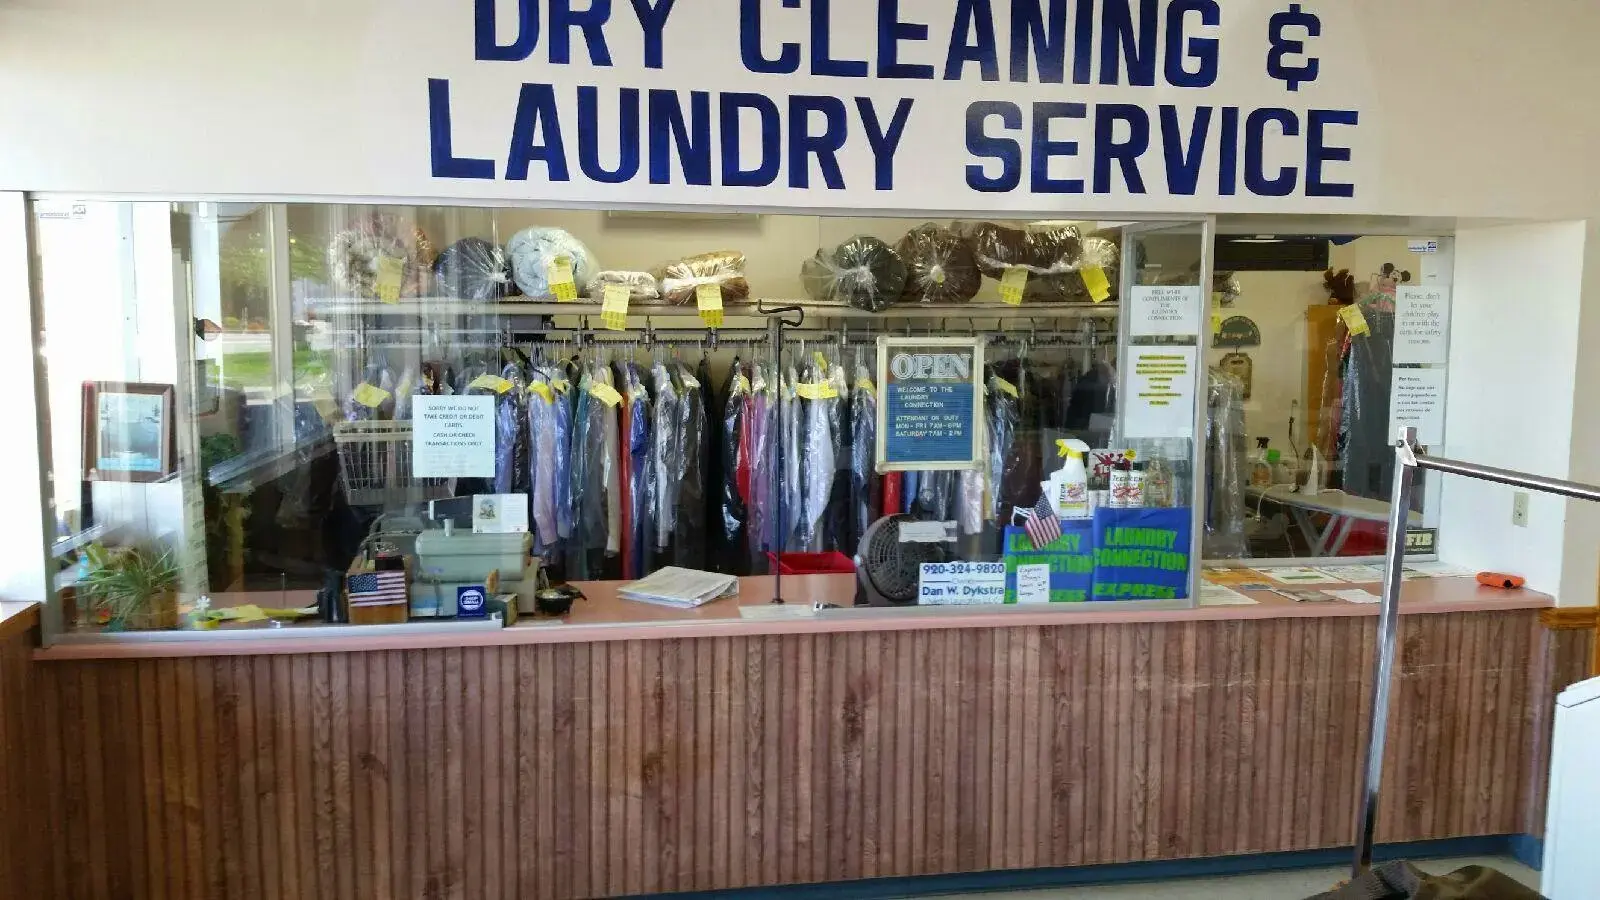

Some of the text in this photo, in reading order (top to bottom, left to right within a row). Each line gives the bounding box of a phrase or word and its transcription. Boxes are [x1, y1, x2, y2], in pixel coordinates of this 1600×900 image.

[474, 0, 1321, 92] DRY CLEANING &
[428, 78, 1359, 198] LAUNDRY SERVICE
[890, 353, 972, 380] OPEN
[1105, 527, 1178, 549] LAUNDRY
[922, 563, 1005, 574] 920-324-9820
[1093, 548, 1188, 572] CONNECTION
[922, 586, 1005, 597] Dan W. Dykstra
